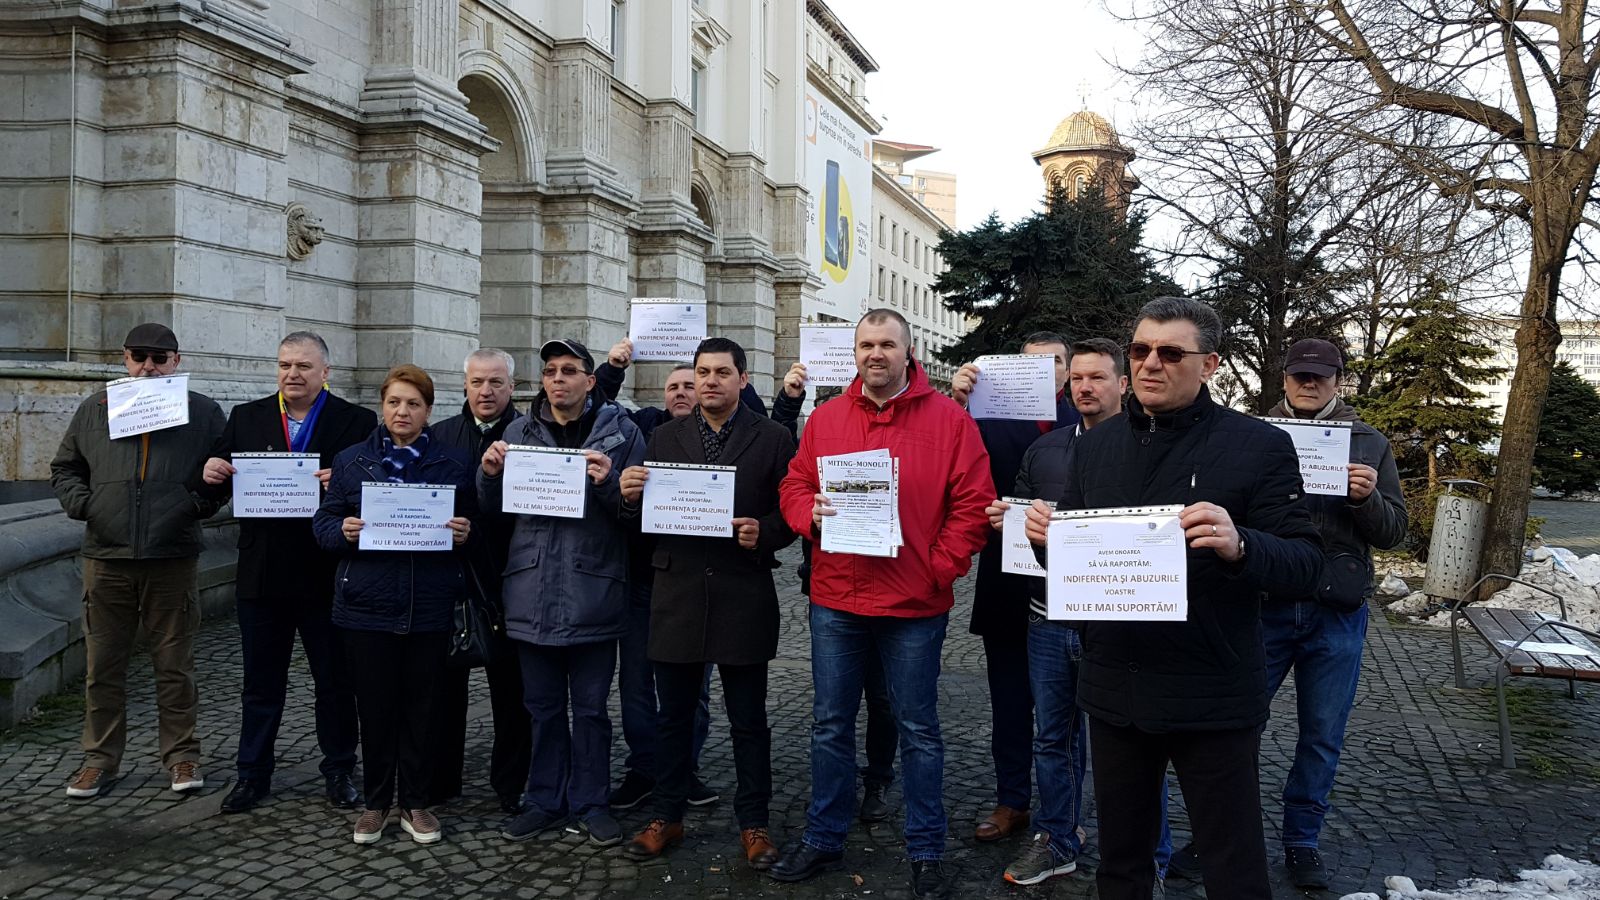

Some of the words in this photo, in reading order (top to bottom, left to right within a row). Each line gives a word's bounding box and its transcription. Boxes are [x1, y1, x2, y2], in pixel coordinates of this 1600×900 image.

[820, 105, 829, 120] Cele
[1095, 604, 1114, 612] MAI
[1117, 602, 1177, 612] SUPORTĂM!
